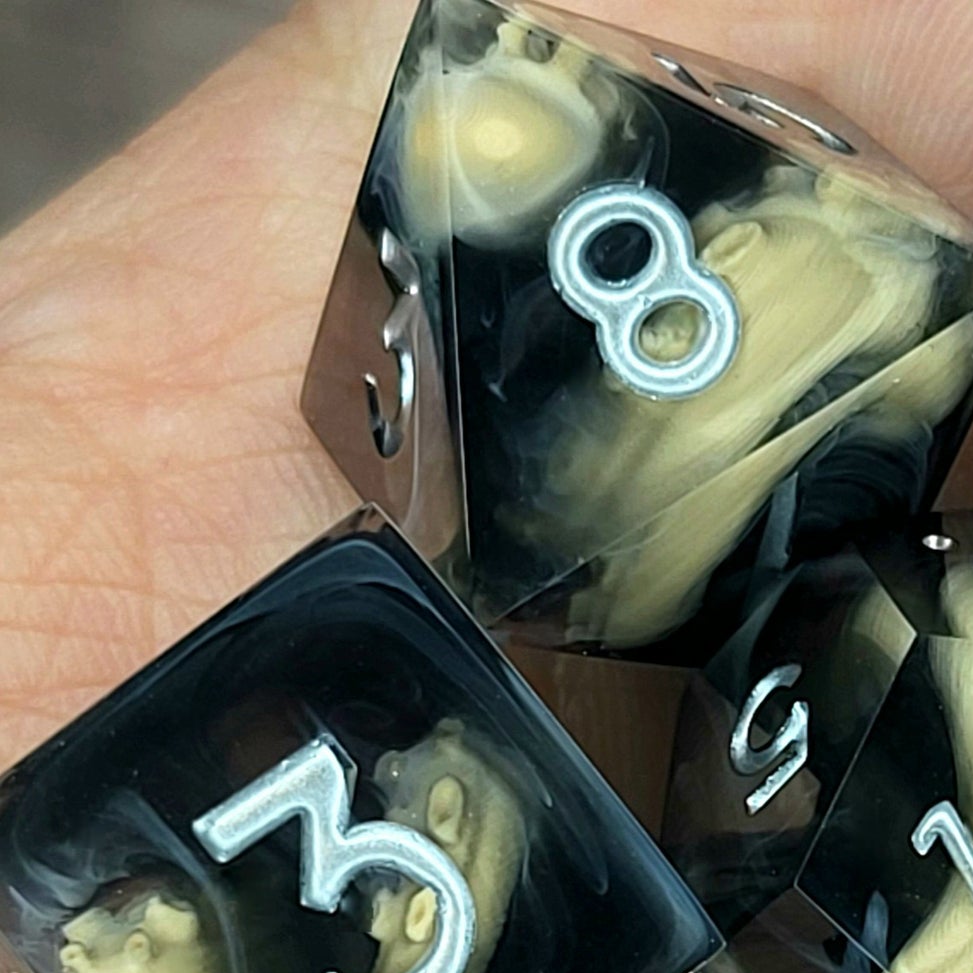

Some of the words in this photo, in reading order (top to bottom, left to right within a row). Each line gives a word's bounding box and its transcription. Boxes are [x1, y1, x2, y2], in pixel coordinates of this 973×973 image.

[362, 227, 419, 459] 3
[547, 183, 740, 399] 8
[729, 664, 809, 816] 5
